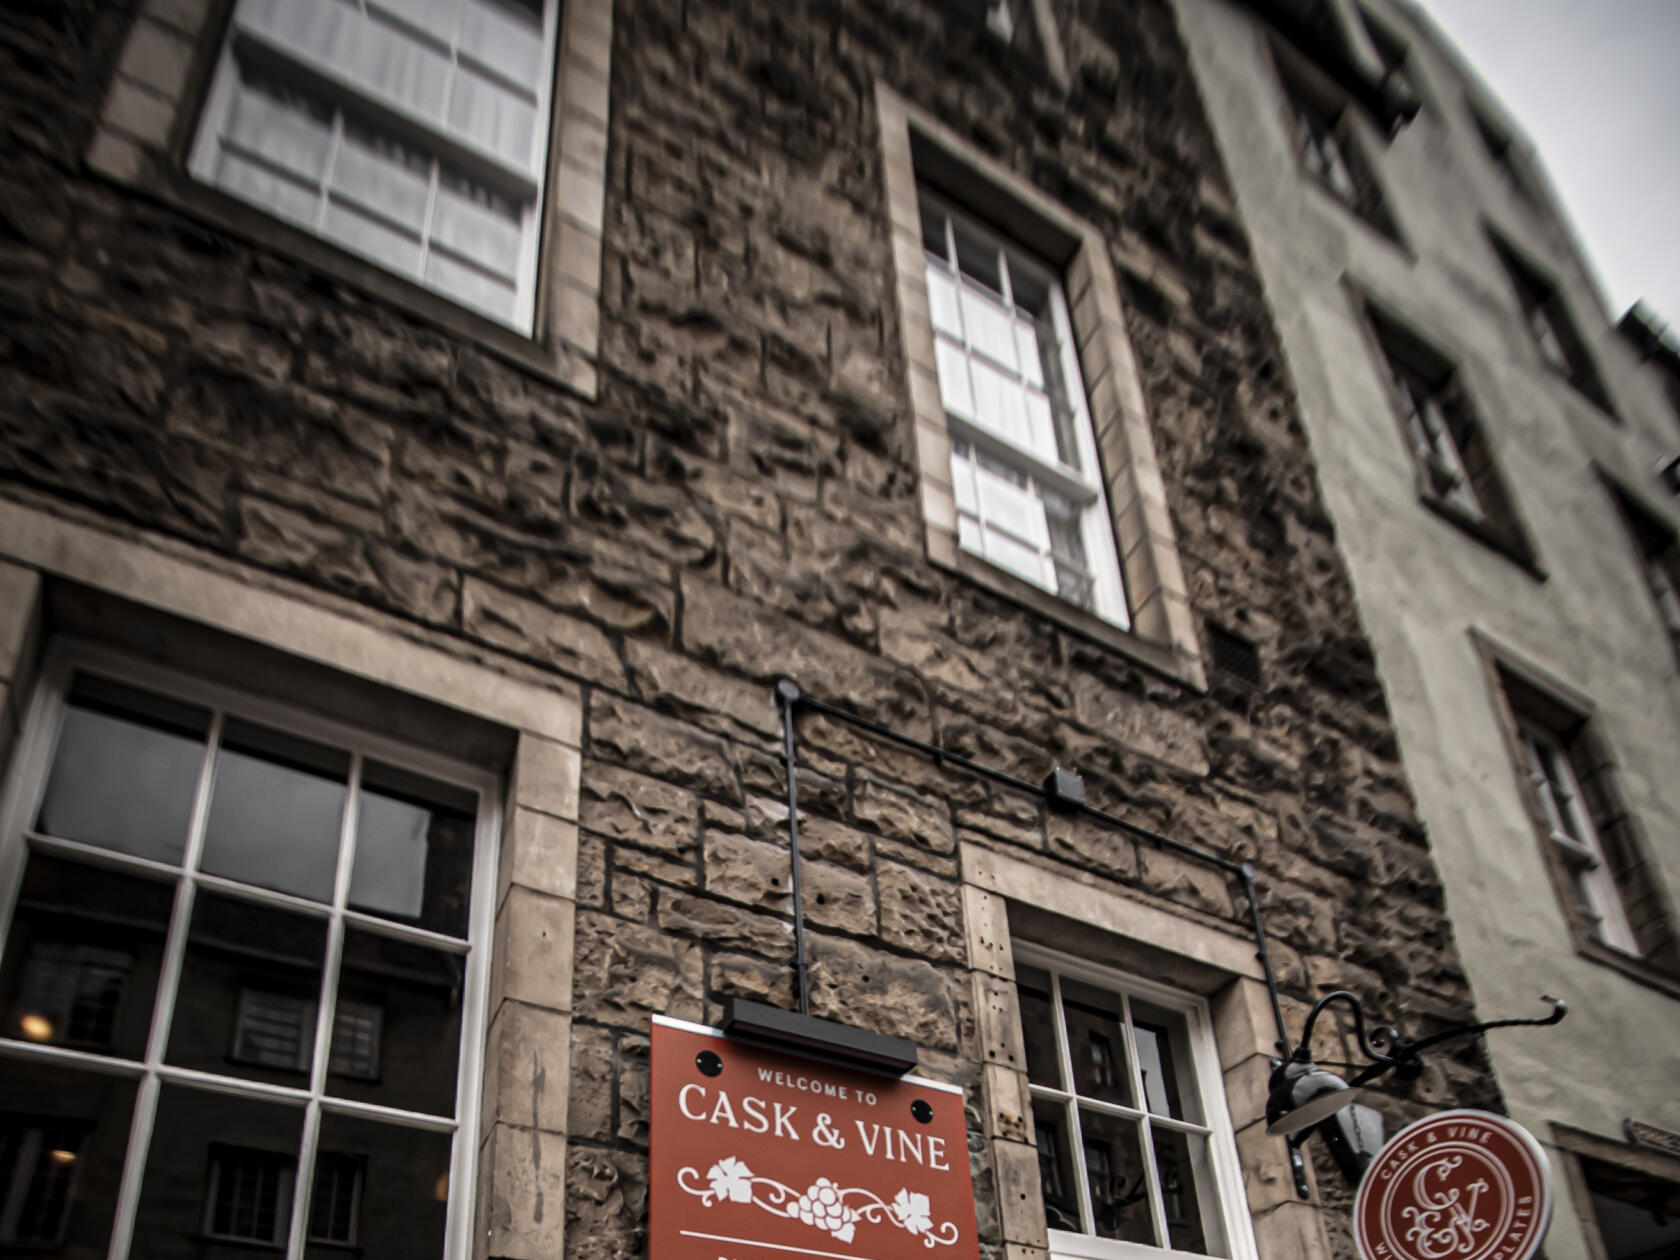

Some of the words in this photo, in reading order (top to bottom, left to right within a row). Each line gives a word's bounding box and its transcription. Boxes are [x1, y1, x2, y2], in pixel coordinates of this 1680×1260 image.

[758, 1067, 847, 1100] WELCOME
[856, 1090, 878, 1106] TO
[678, 1083, 800, 1141] CASK
[812, 1112, 845, 1149] &
[854, 1120, 950, 1172] VINE
[1381, 1142, 1419, 1180] CASK
[1426, 1131, 1438, 1143] &
[1447, 1126, 1493, 1144] VINE
